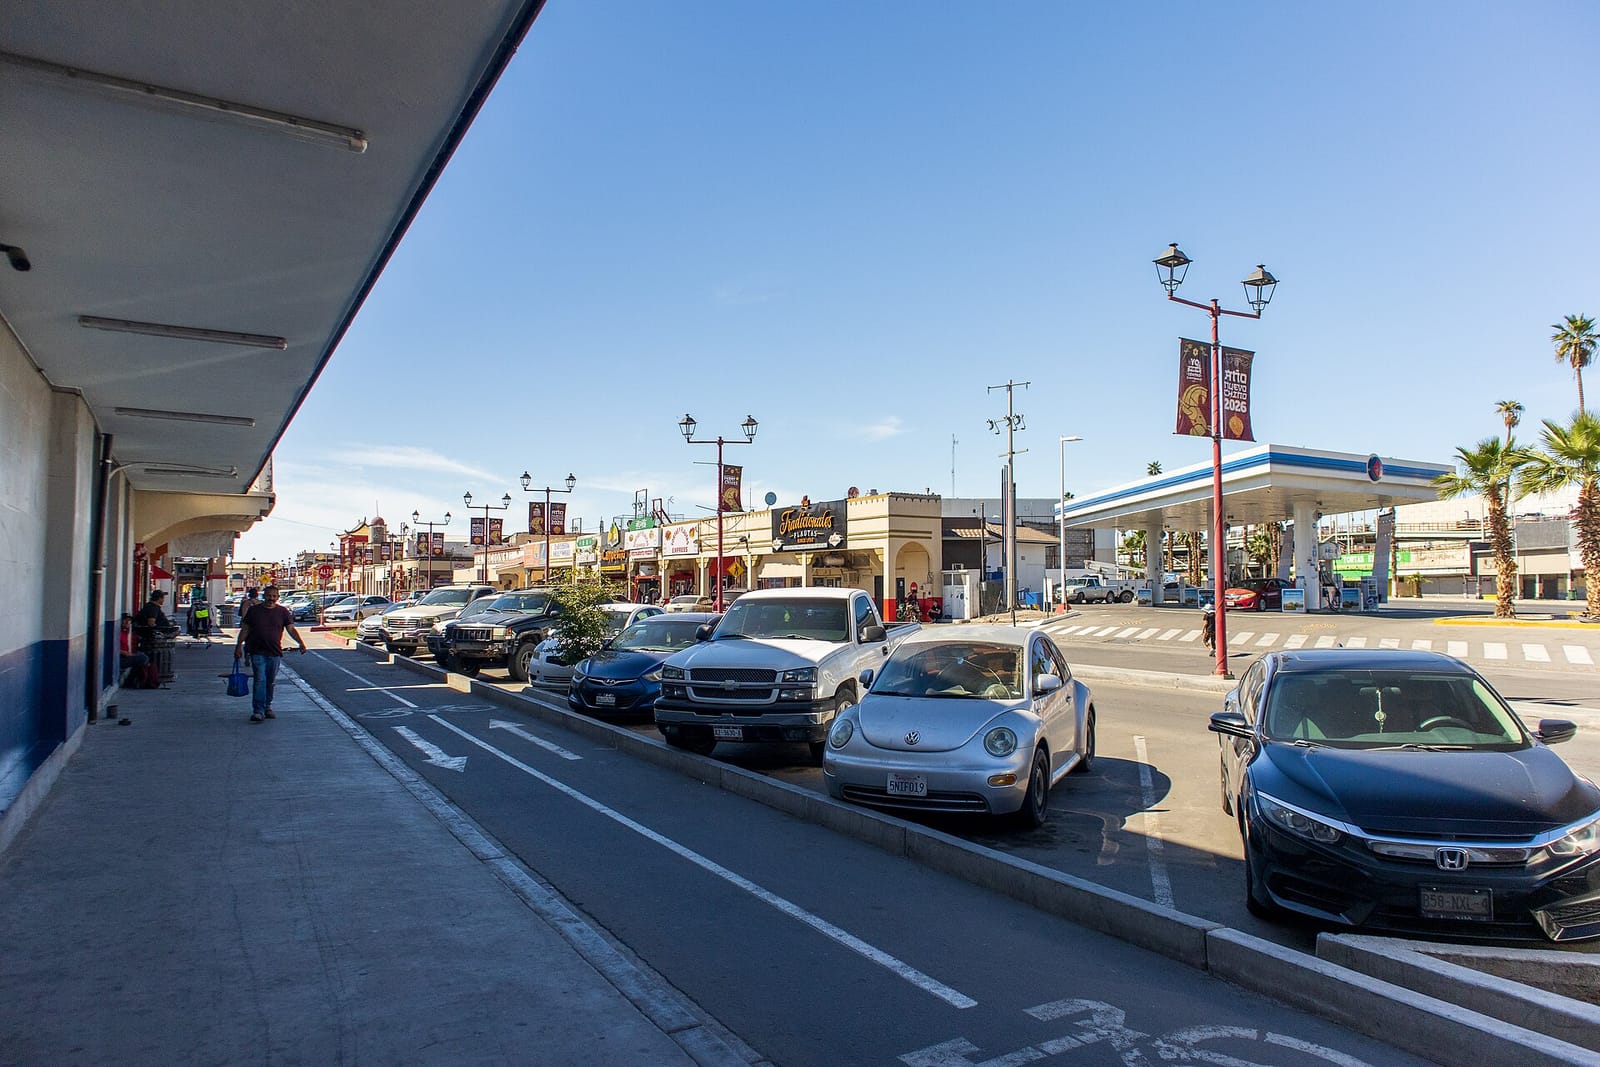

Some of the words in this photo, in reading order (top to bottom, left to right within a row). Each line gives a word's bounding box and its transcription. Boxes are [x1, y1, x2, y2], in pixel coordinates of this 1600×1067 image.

[1224, 398, 1247, 413] 2026
[779, 509, 833, 535] Tradicionales
[890, 781, 925, 793] 5NIF019
